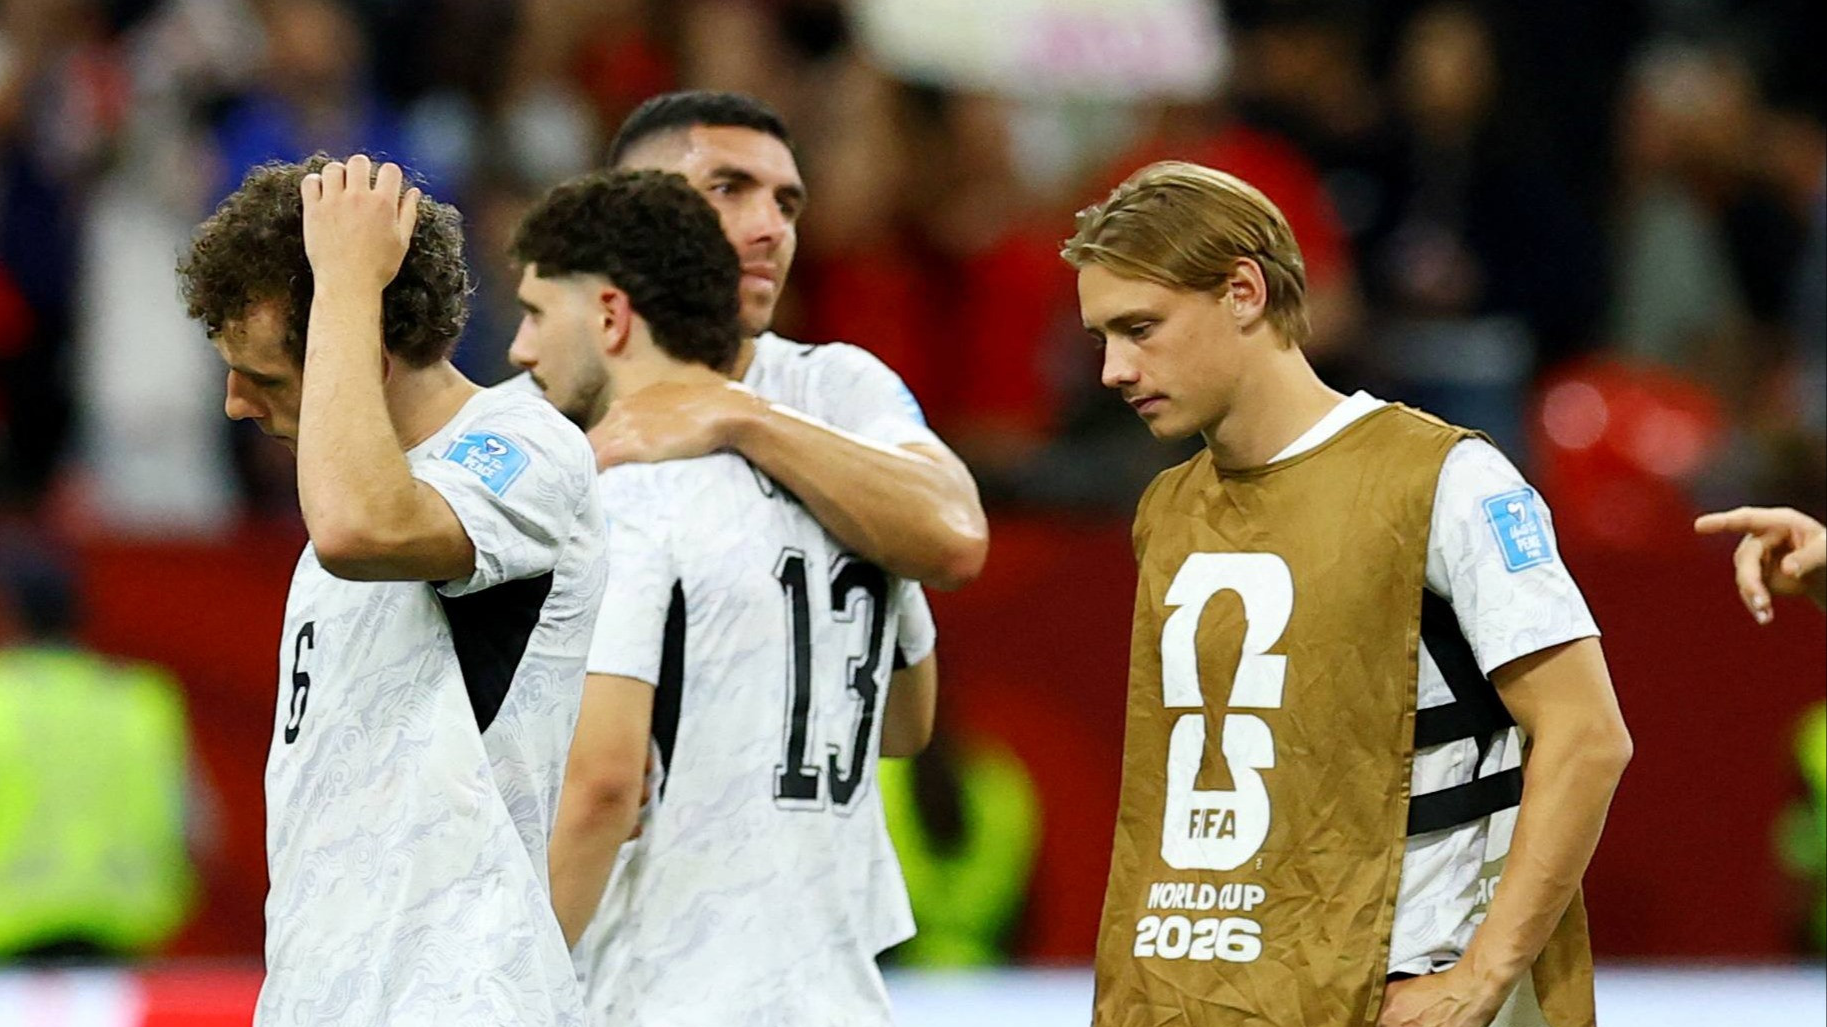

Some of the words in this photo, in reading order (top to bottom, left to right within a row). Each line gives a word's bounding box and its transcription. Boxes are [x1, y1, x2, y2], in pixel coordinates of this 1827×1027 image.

[284, 620, 316, 744] 6
[773, 547, 897, 815] 13
[1188, 808, 1236, 840] FIFA
[1147, 882, 1216, 911] WORLD
[1218, 883, 1266, 912] CUP
[1133, 914, 1263, 963] 2026
